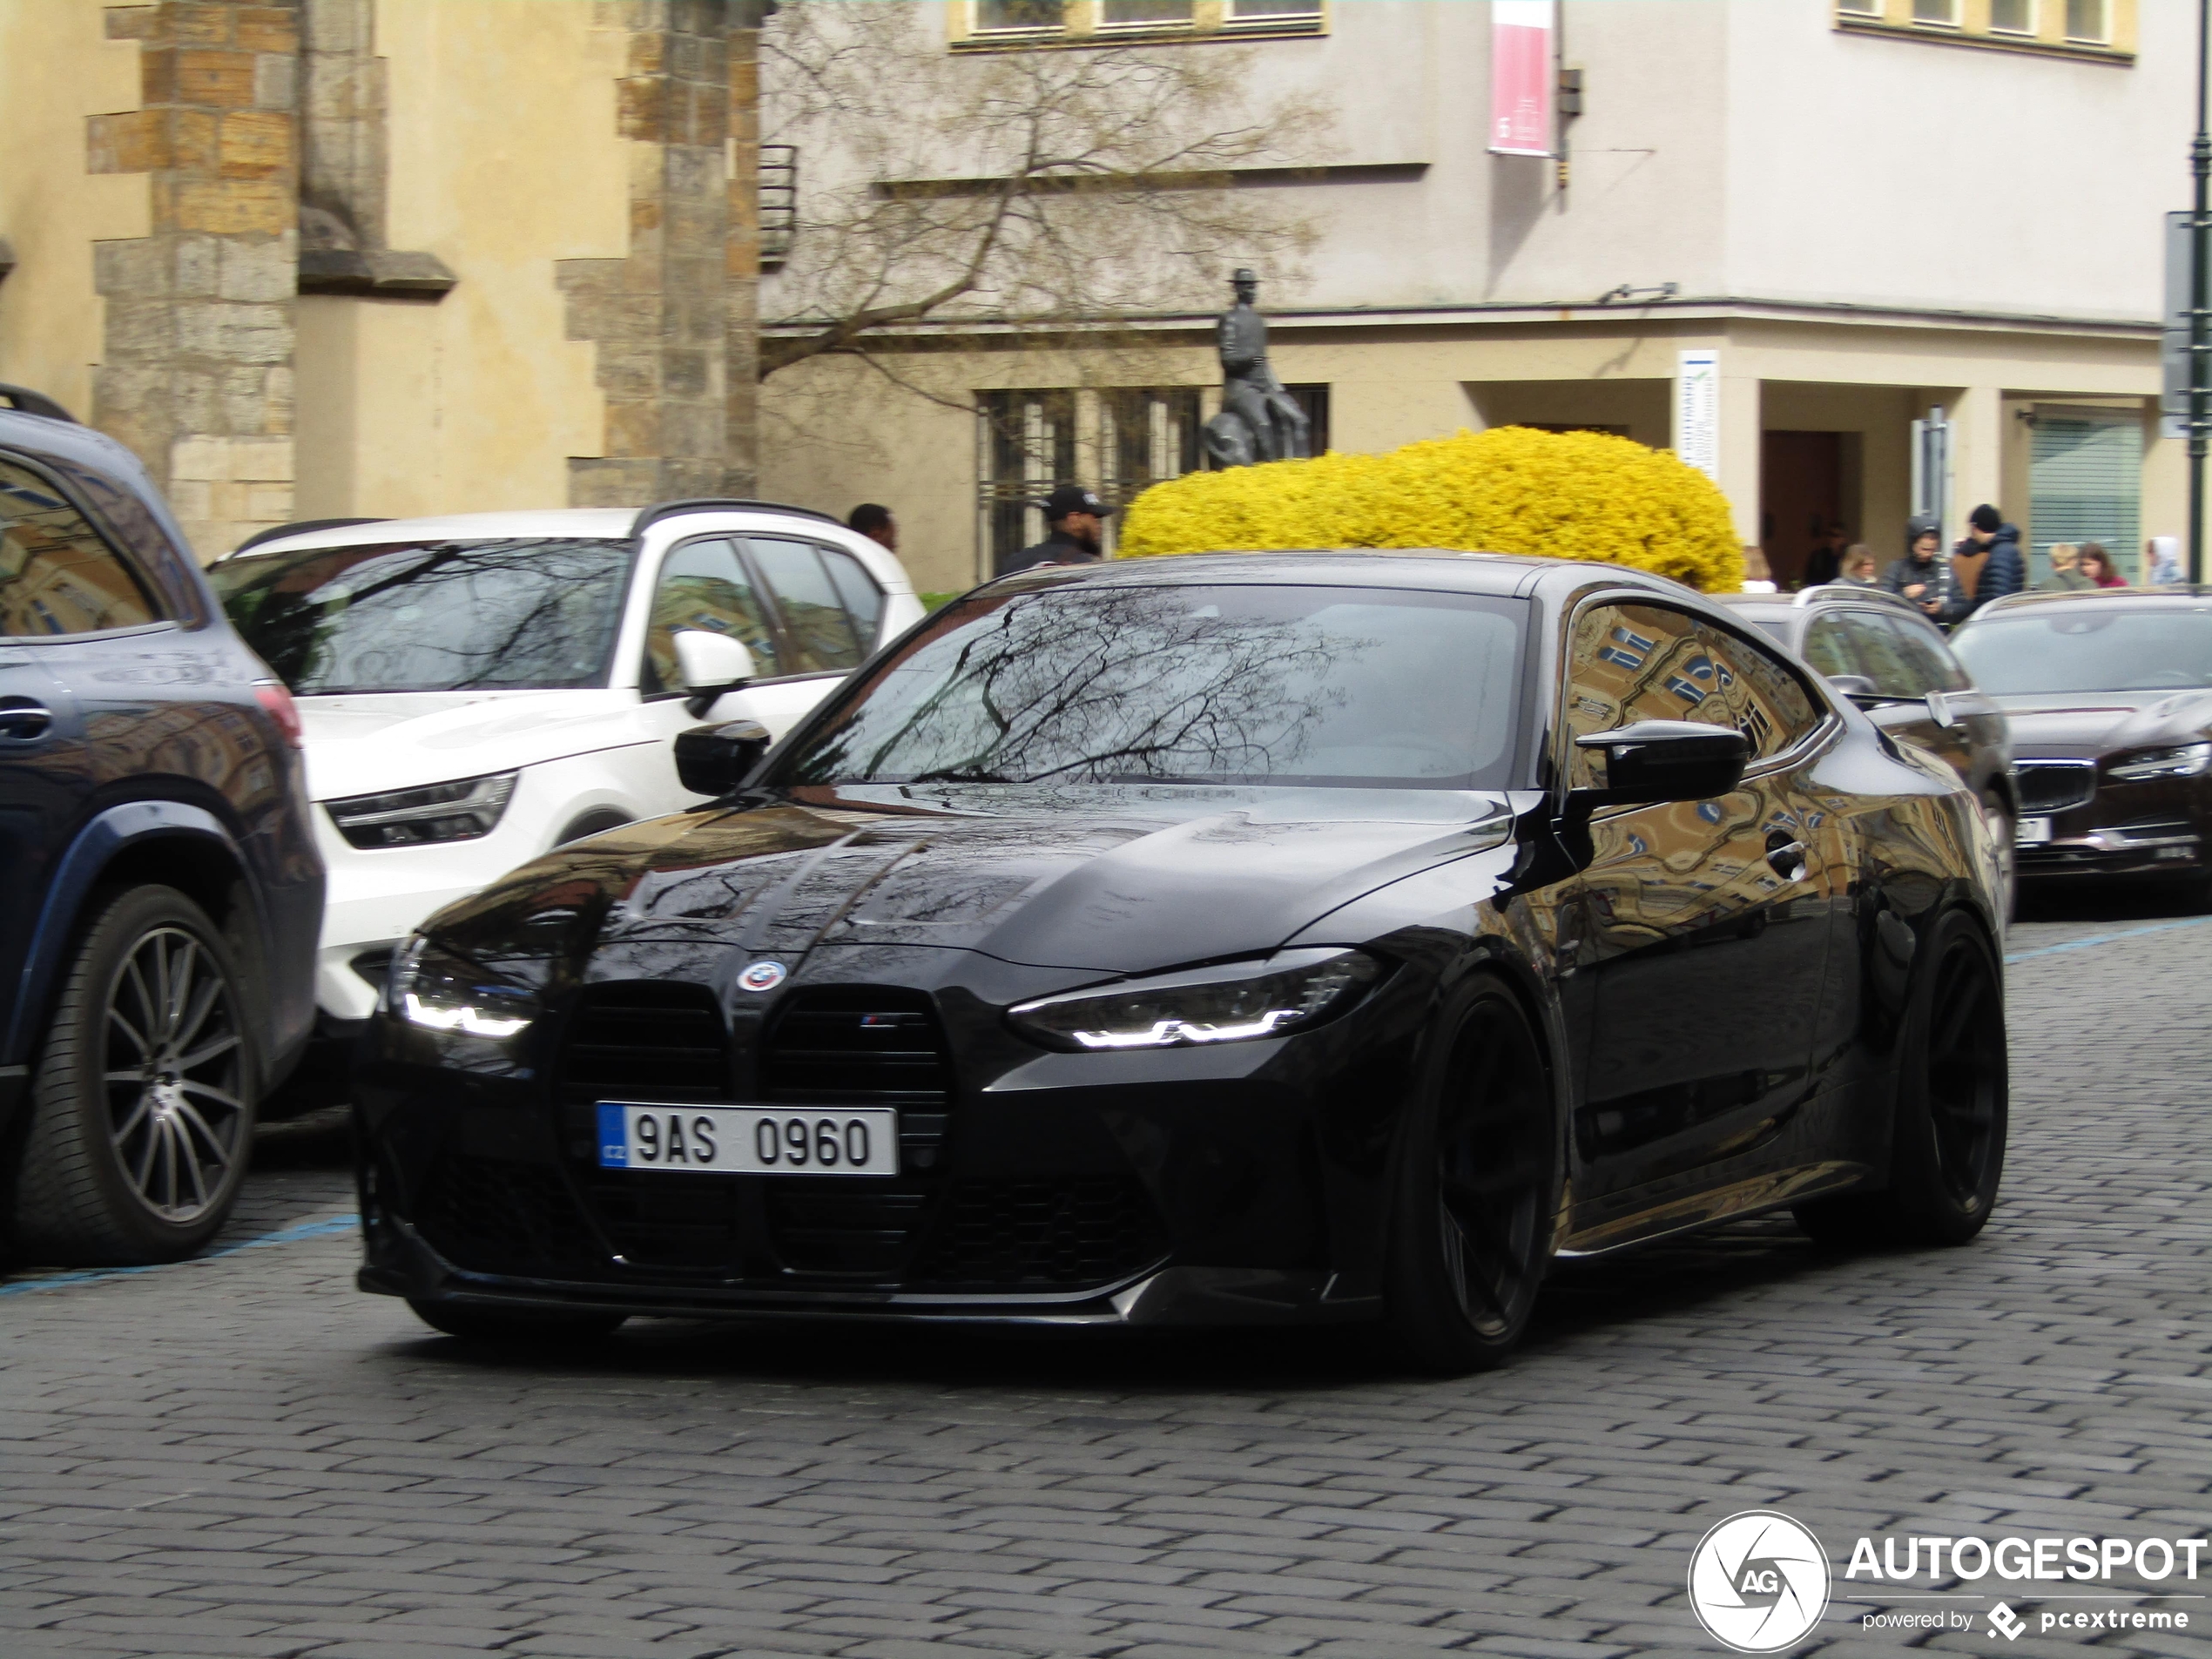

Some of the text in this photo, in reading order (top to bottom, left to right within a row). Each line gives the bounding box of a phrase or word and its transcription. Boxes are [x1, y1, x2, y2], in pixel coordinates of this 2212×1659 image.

[603, 1145, 626, 1159] CZ
[637, 1113, 870, 1166] 9AS 0960
